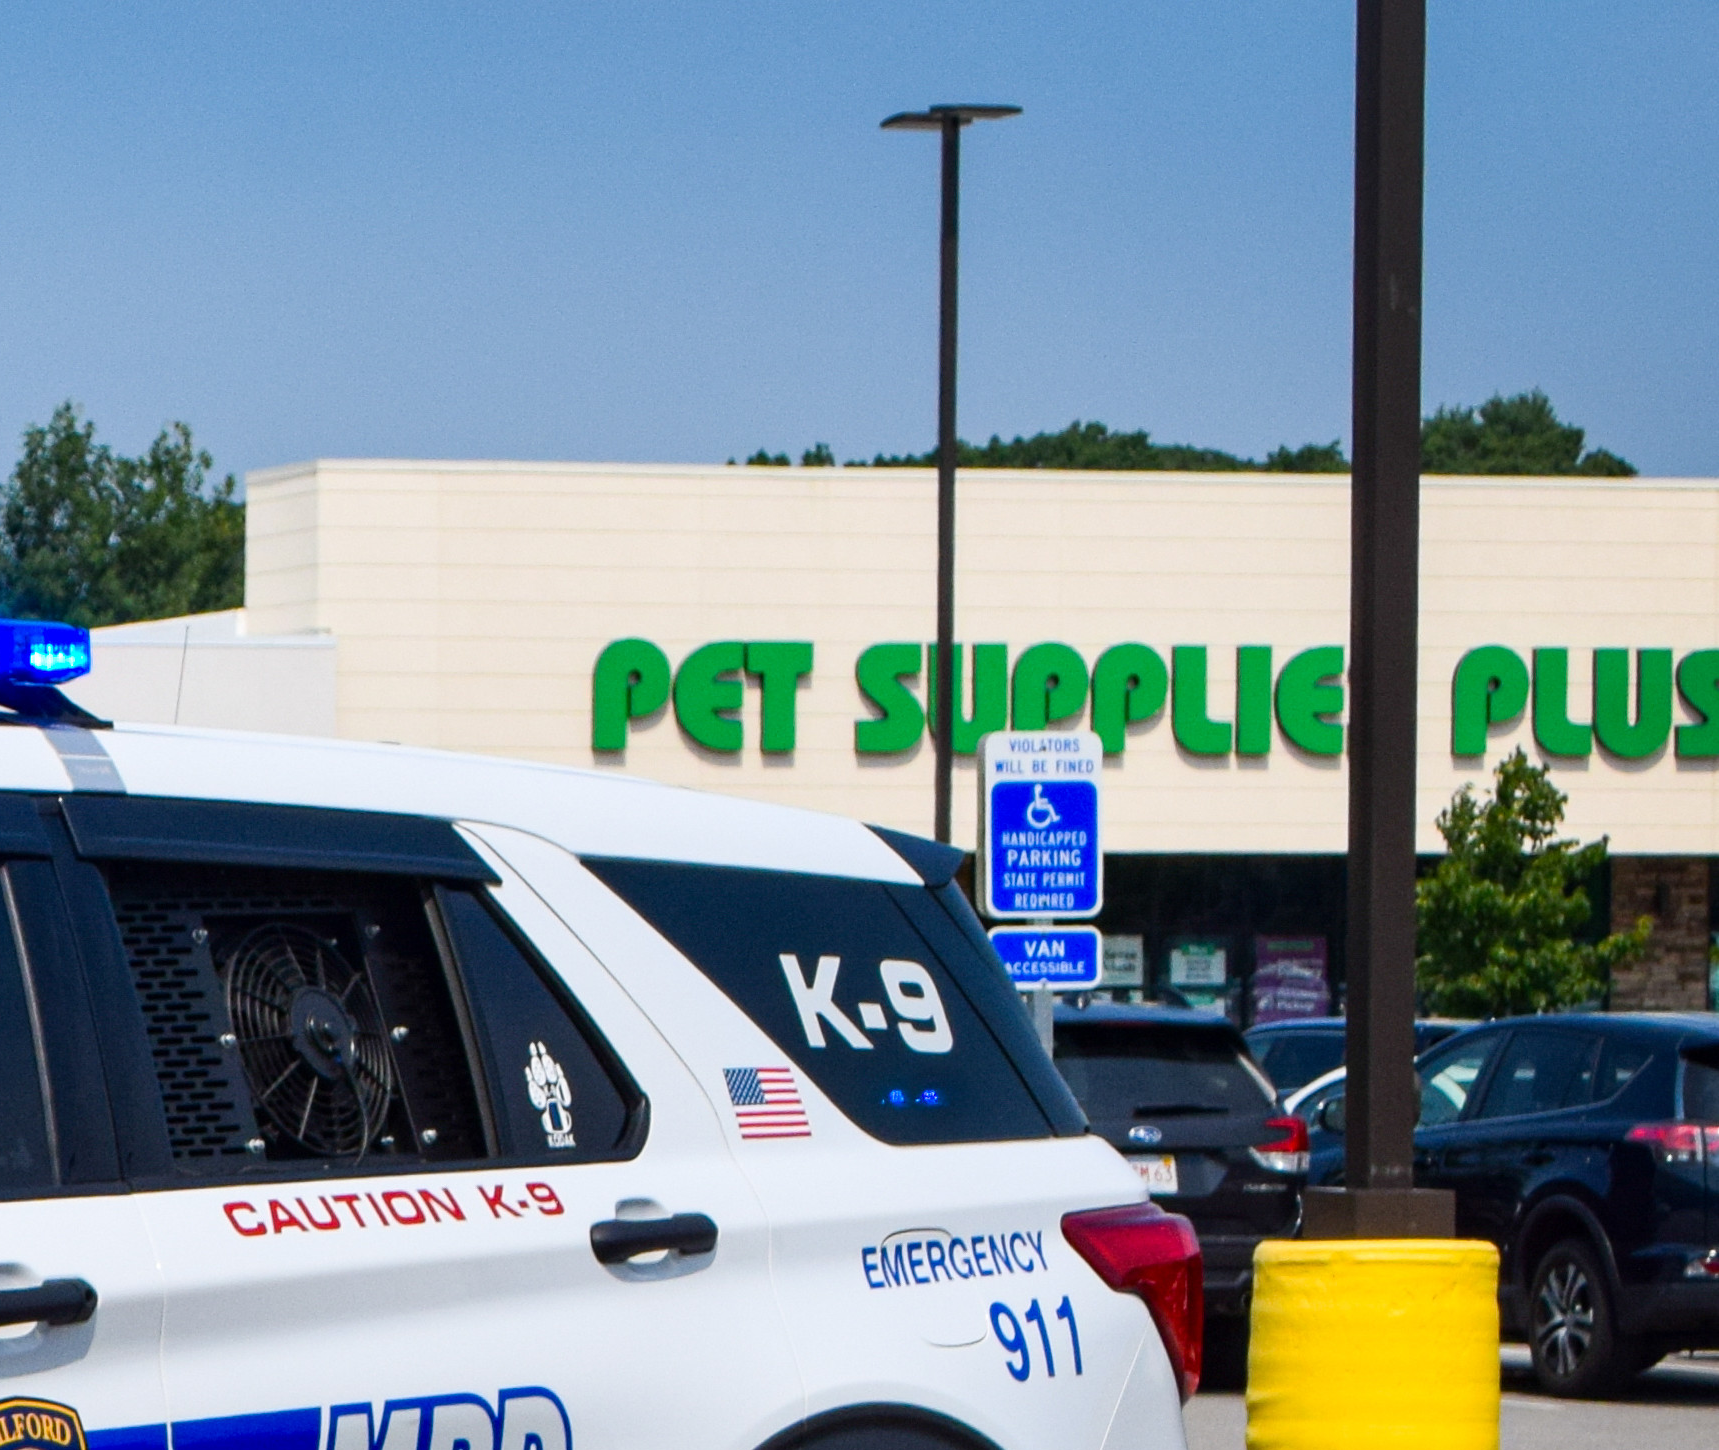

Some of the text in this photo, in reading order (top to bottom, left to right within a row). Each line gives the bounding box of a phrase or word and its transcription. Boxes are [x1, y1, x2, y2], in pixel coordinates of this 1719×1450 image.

[592, 638, 1719, 758] PET SUPPLIE PLUS
[1009, 738, 1080, 752] VIOLATORS
[995, 760, 1094, 773] WILL BE FINED
[1002, 831, 1087, 847] HANDICAPPED
[1007, 849, 1082, 867] PARKING
[1003, 872, 1086, 888] STATE PERMIT
[1014, 893, 1075, 910] REQUIRED
[1024, 940, 1065, 958] VAN
[778, 953, 954, 1054] K-9
[222, 1182, 565, 1236] CAUTION K-9
[862, 1231, 1049, 1290] EMERGENCY
[989, 1295, 1083, 1382] 911
